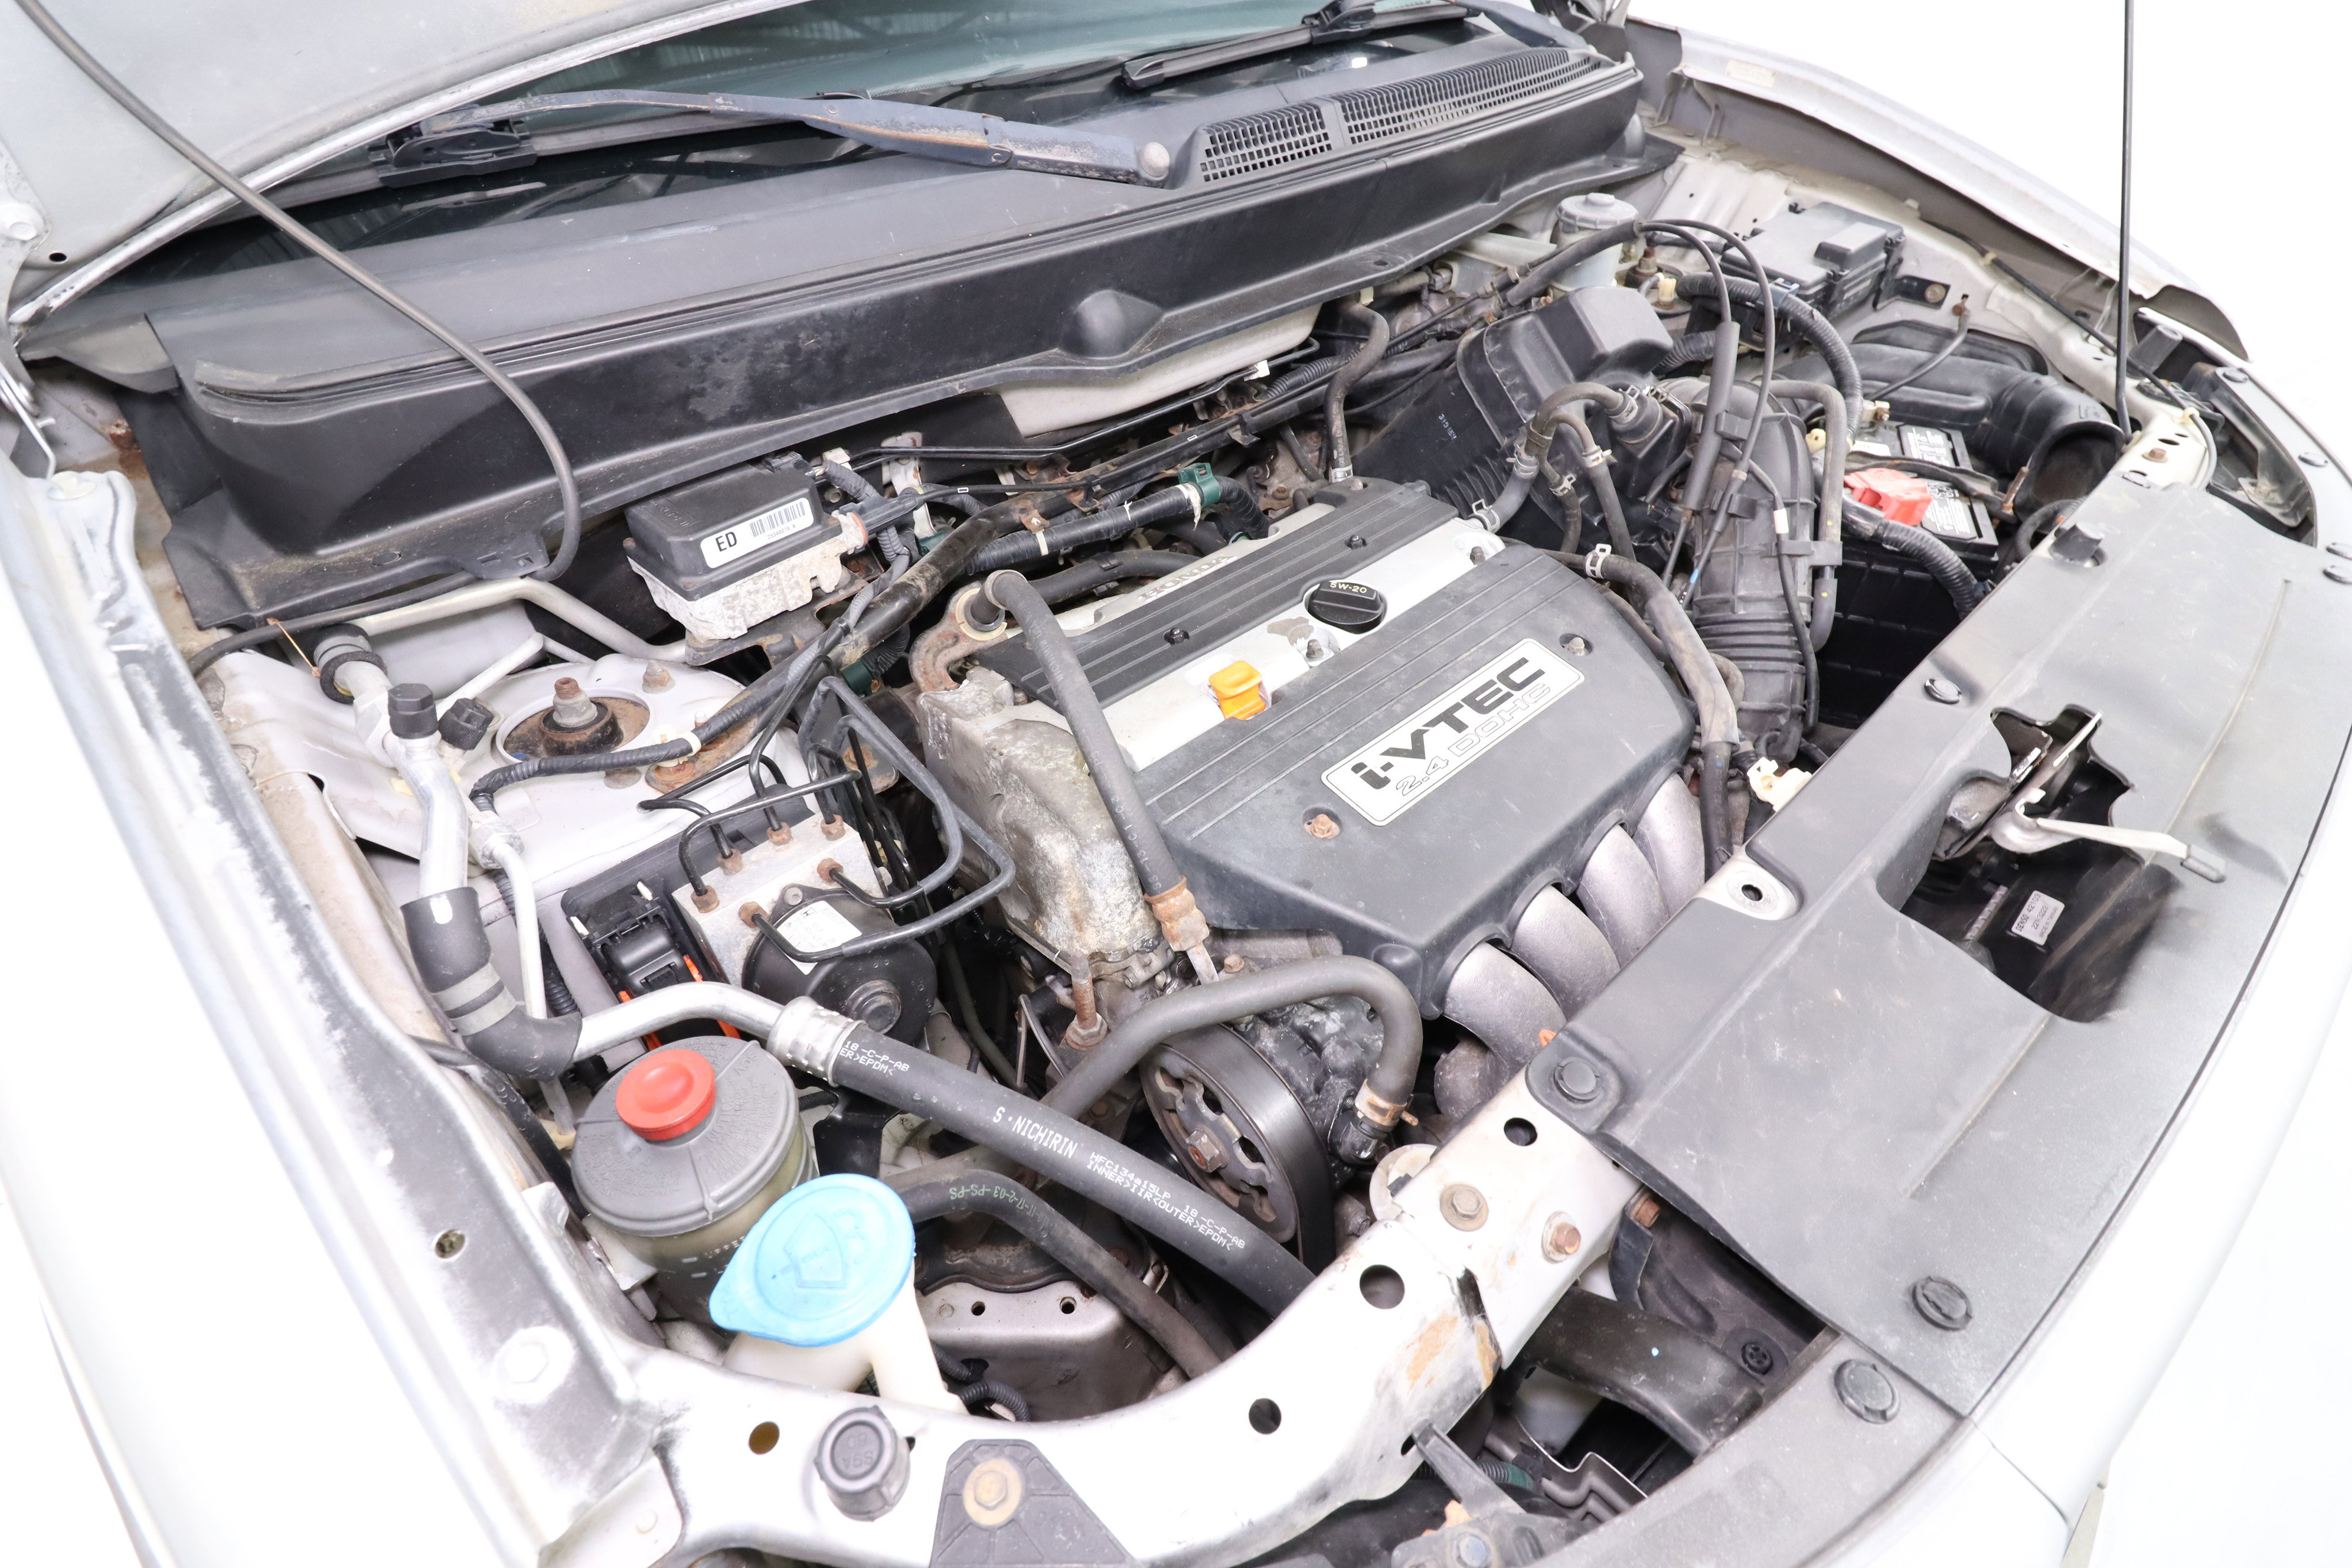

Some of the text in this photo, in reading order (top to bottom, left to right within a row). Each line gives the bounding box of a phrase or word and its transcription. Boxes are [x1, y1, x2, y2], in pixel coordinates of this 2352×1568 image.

[715, 531, 738, 552] ED
[1329, 582, 1367, 593] 5W-20
[1350, 657, 1545, 790] i-VTEC
[1396, 682, 1551, 796] 2.4 DOHC
[2015, 914, 2029, 932] DENSO
[844, 1040, 860, 1051] 18
[1012, 1115, 1079, 1159] NICHIRIN
[1183, 1204, 1199, 1218] 18
